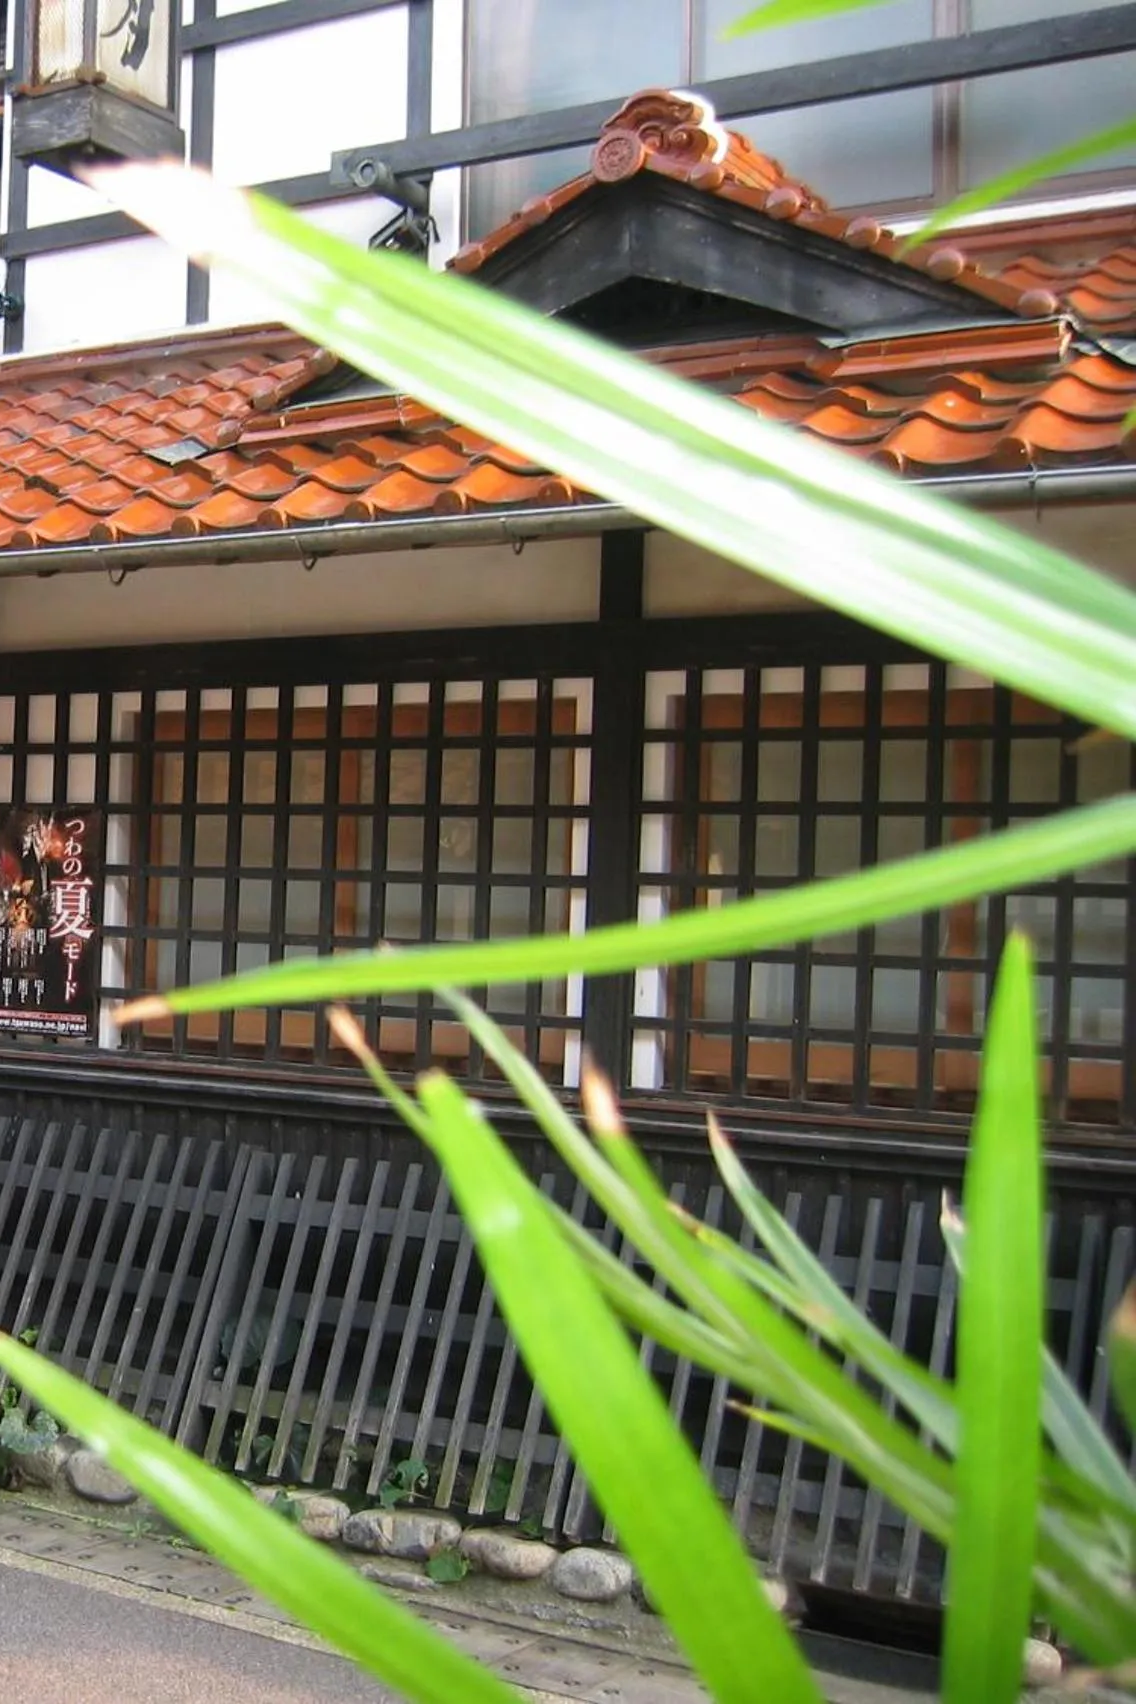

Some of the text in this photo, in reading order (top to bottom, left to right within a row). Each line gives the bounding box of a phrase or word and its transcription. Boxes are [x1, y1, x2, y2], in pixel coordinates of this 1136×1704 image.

[50, 818, 95, 1001] つわの夏モード
